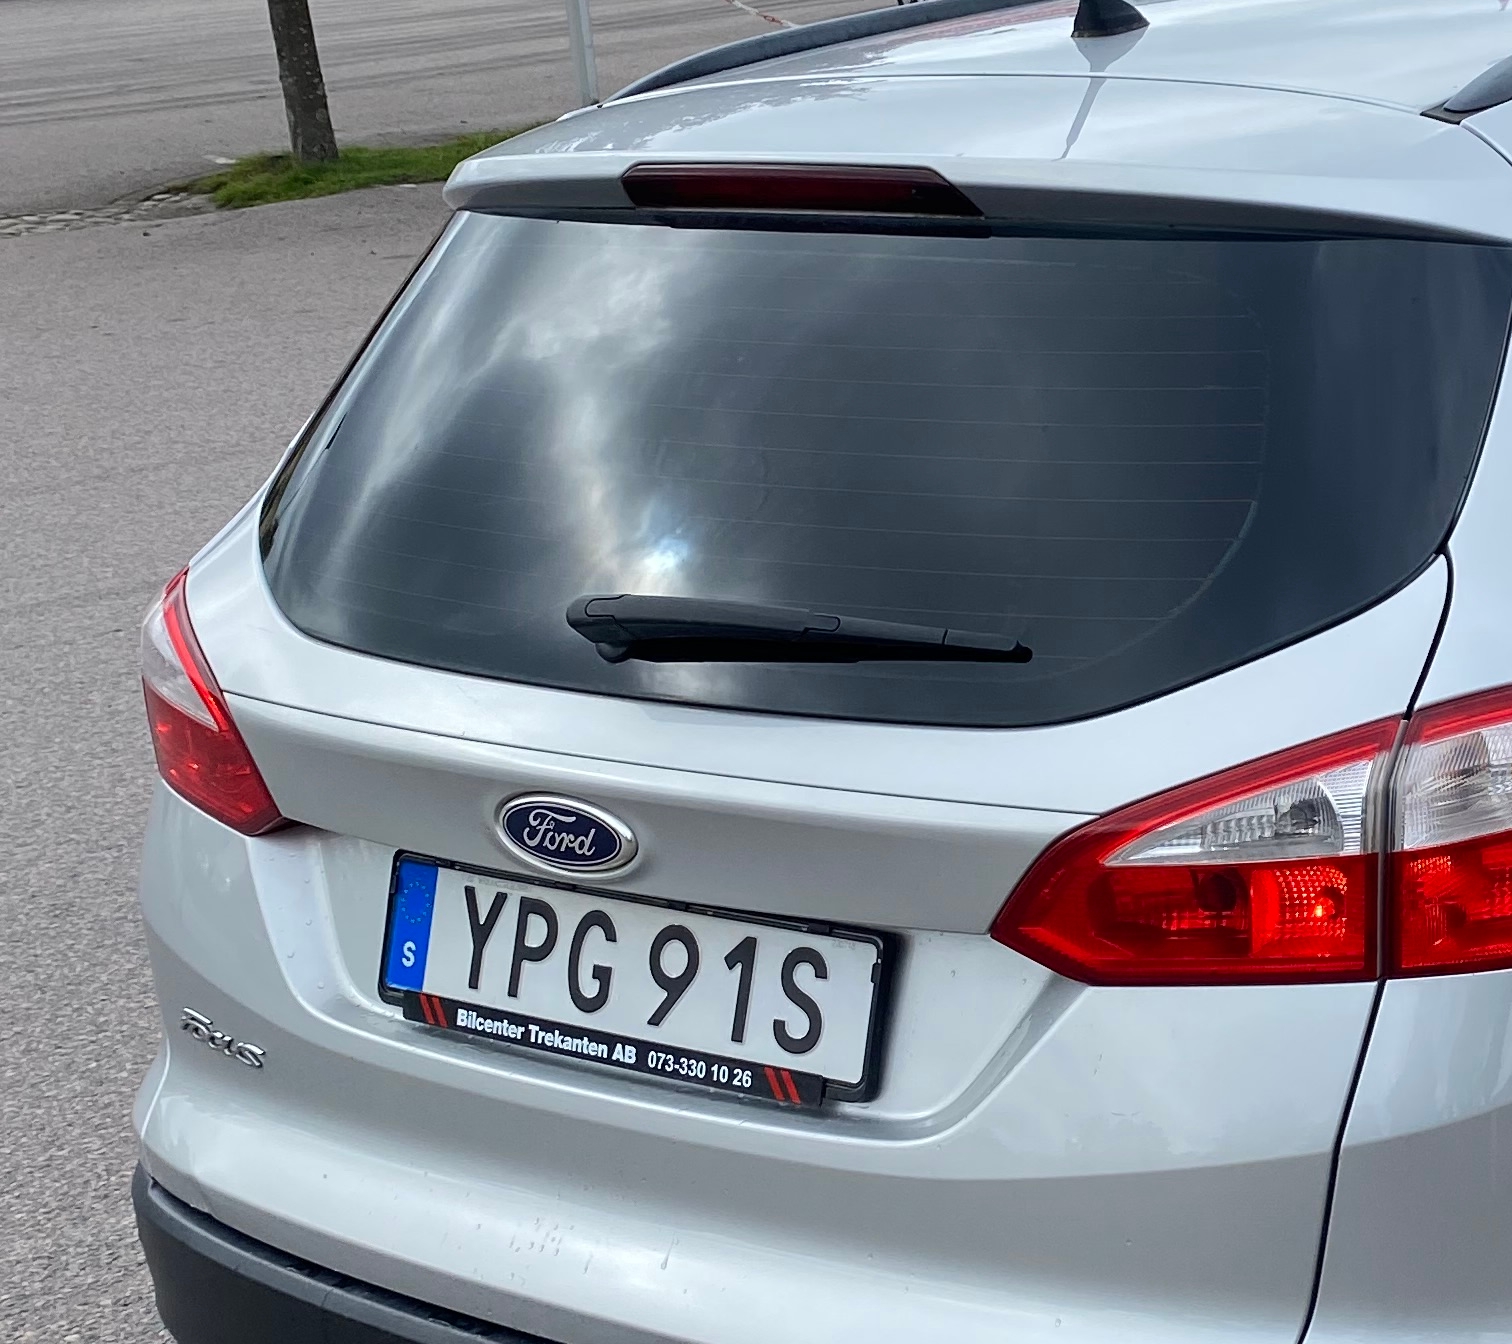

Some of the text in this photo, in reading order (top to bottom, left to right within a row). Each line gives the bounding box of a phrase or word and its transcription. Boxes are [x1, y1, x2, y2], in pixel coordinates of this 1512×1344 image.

[523, 808, 596, 857] Ford
[401, 885, 829, 1055] S YPG 91S
[456, 1008, 753, 1089] Bilcenter Trekanten AB 073-330 10 26
